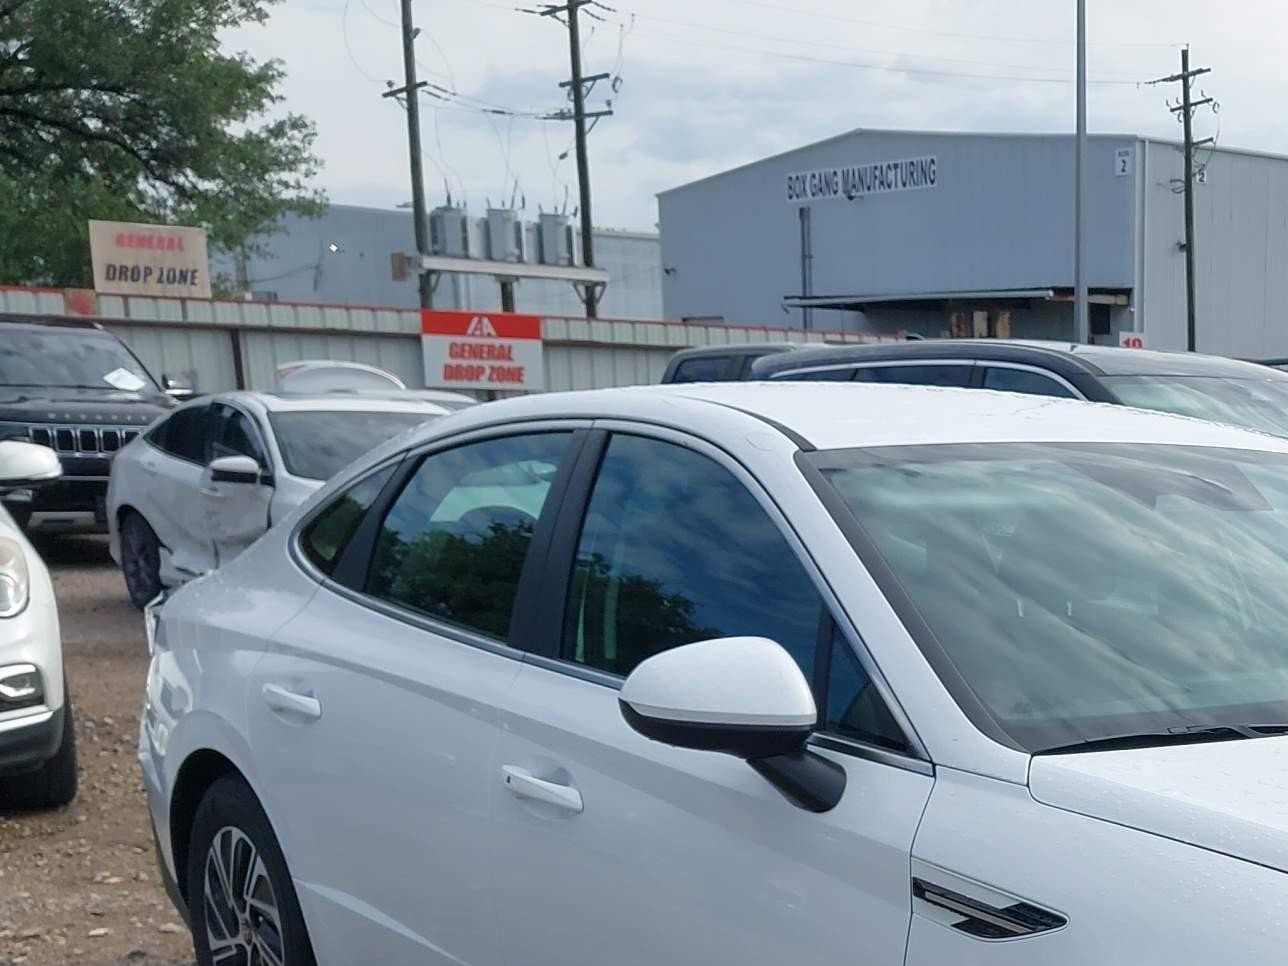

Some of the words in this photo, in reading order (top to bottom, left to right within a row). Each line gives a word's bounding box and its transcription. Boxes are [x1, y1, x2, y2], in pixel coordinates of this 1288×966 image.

[786, 175, 808, 200] BOX
[809, 169, 840, 198] GANG
[841, 157, 937, 195] MANUFACTURING
[115, 232, 185, 252] GENERAL
[105, 264, 153, 284] DROP
[156, 267, 199, 287] ZONE
[449, 342, 514, 362] GENERAL
[443, 363, 485, 382] DROP
[488, 366, 525, 384] ZONE
